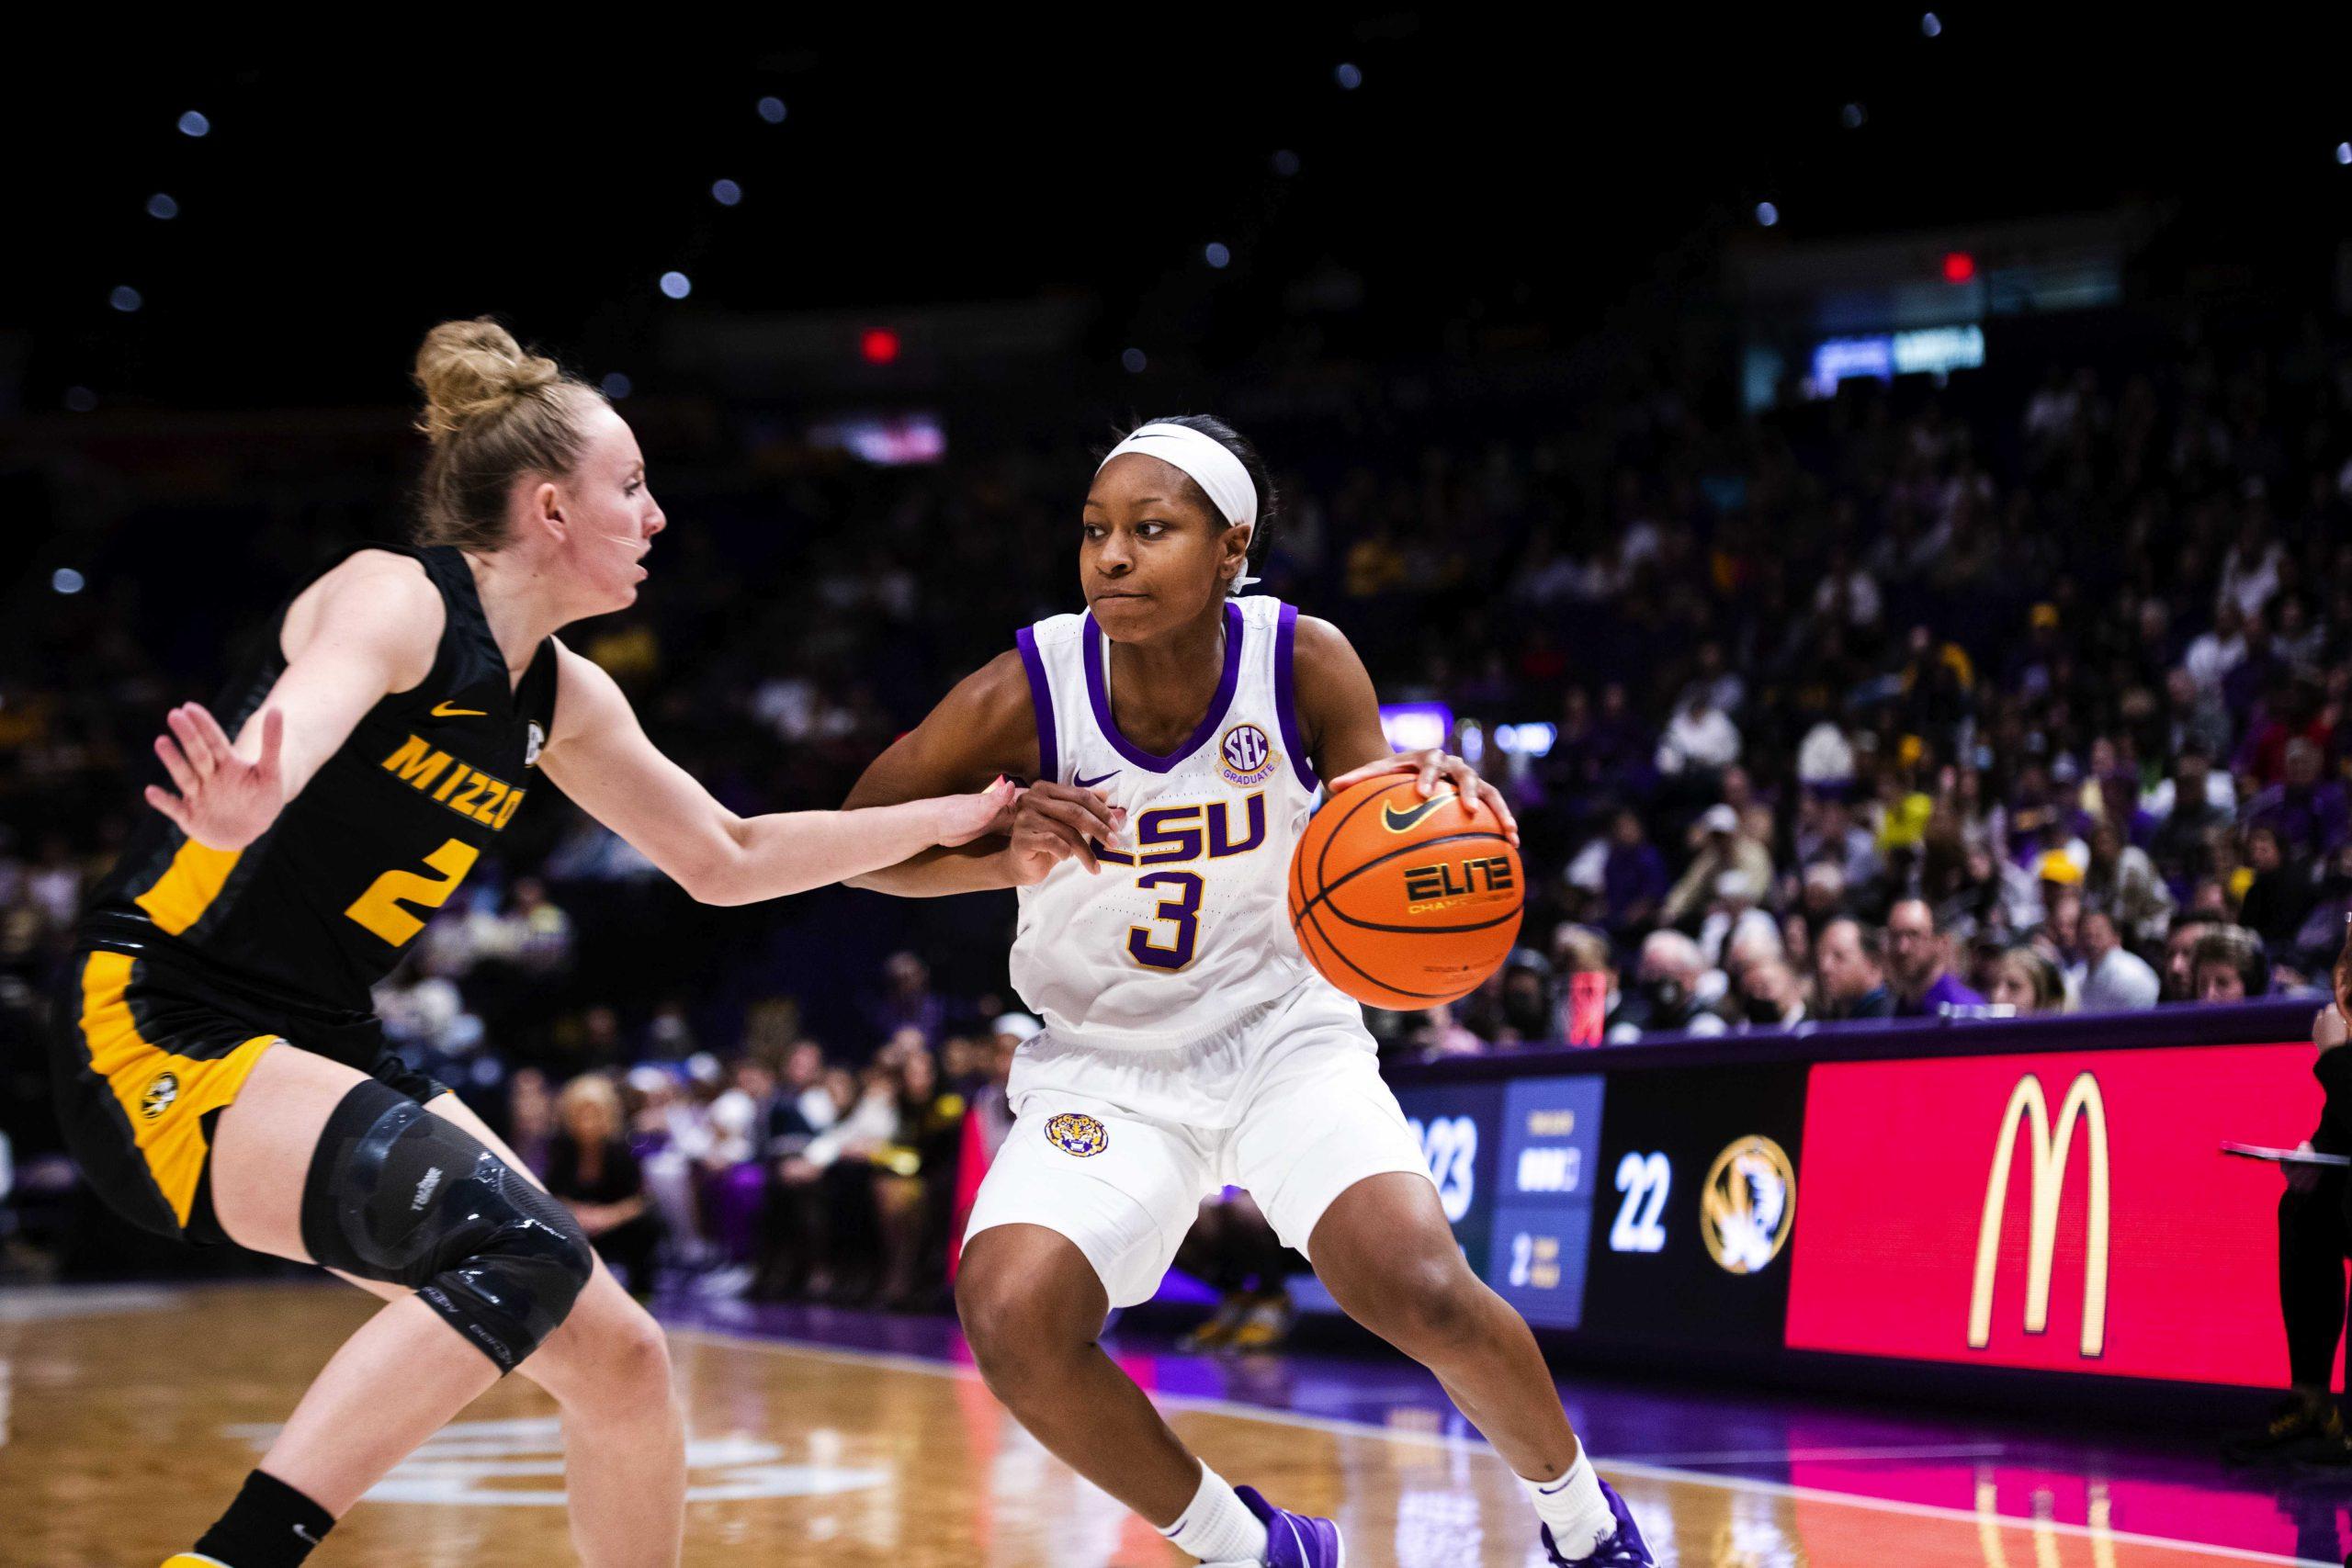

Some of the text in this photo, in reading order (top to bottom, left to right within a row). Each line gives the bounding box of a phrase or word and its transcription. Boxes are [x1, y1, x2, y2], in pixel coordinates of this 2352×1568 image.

[1223, 762, 1275, 785] GRADUATE
[1225, 727, 1267, 770] SEC
[344, 837, 481, 948] 2
[1404, 855, 1514, 901] ELITE
[1126, 869, 1205, 973] 3
[1611, 1151, 1671, 1253] 22
